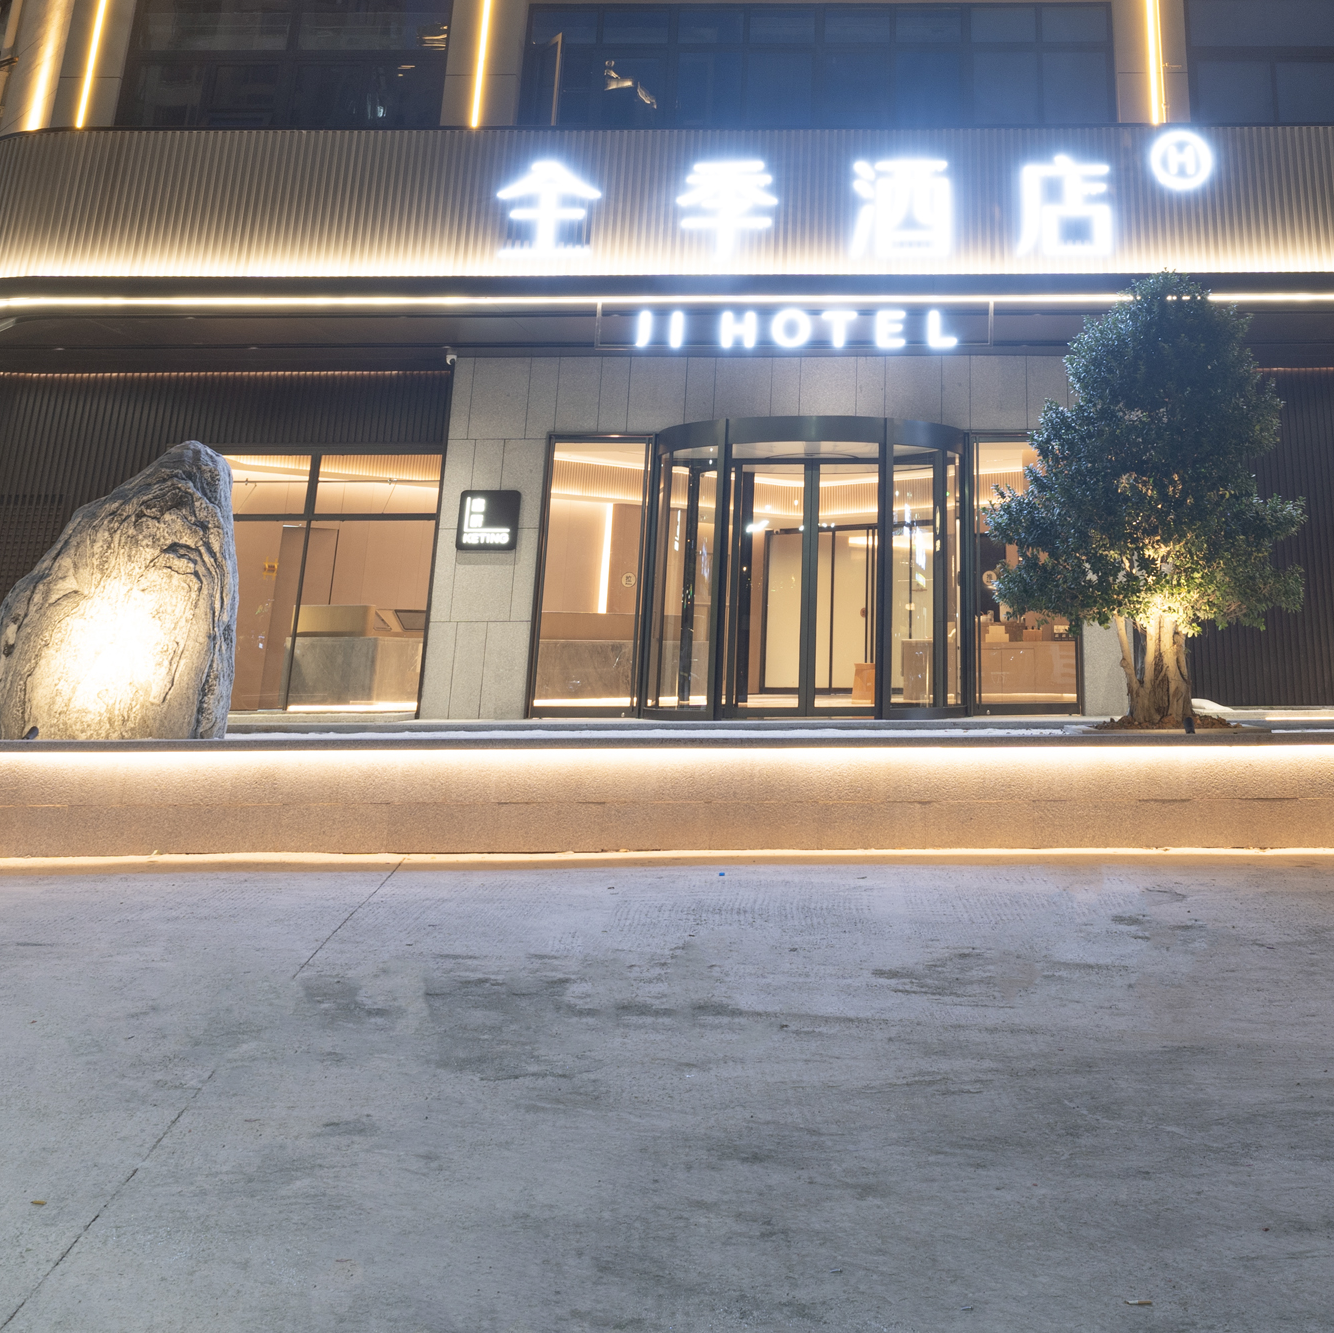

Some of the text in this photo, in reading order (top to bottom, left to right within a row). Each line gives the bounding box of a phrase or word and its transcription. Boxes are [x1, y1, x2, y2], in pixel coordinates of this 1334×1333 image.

[496, 153, 1115, 260] 全季酒店
[720, 308, 958, 350] HOTEL
[462, 532, 510, 544] KETING
